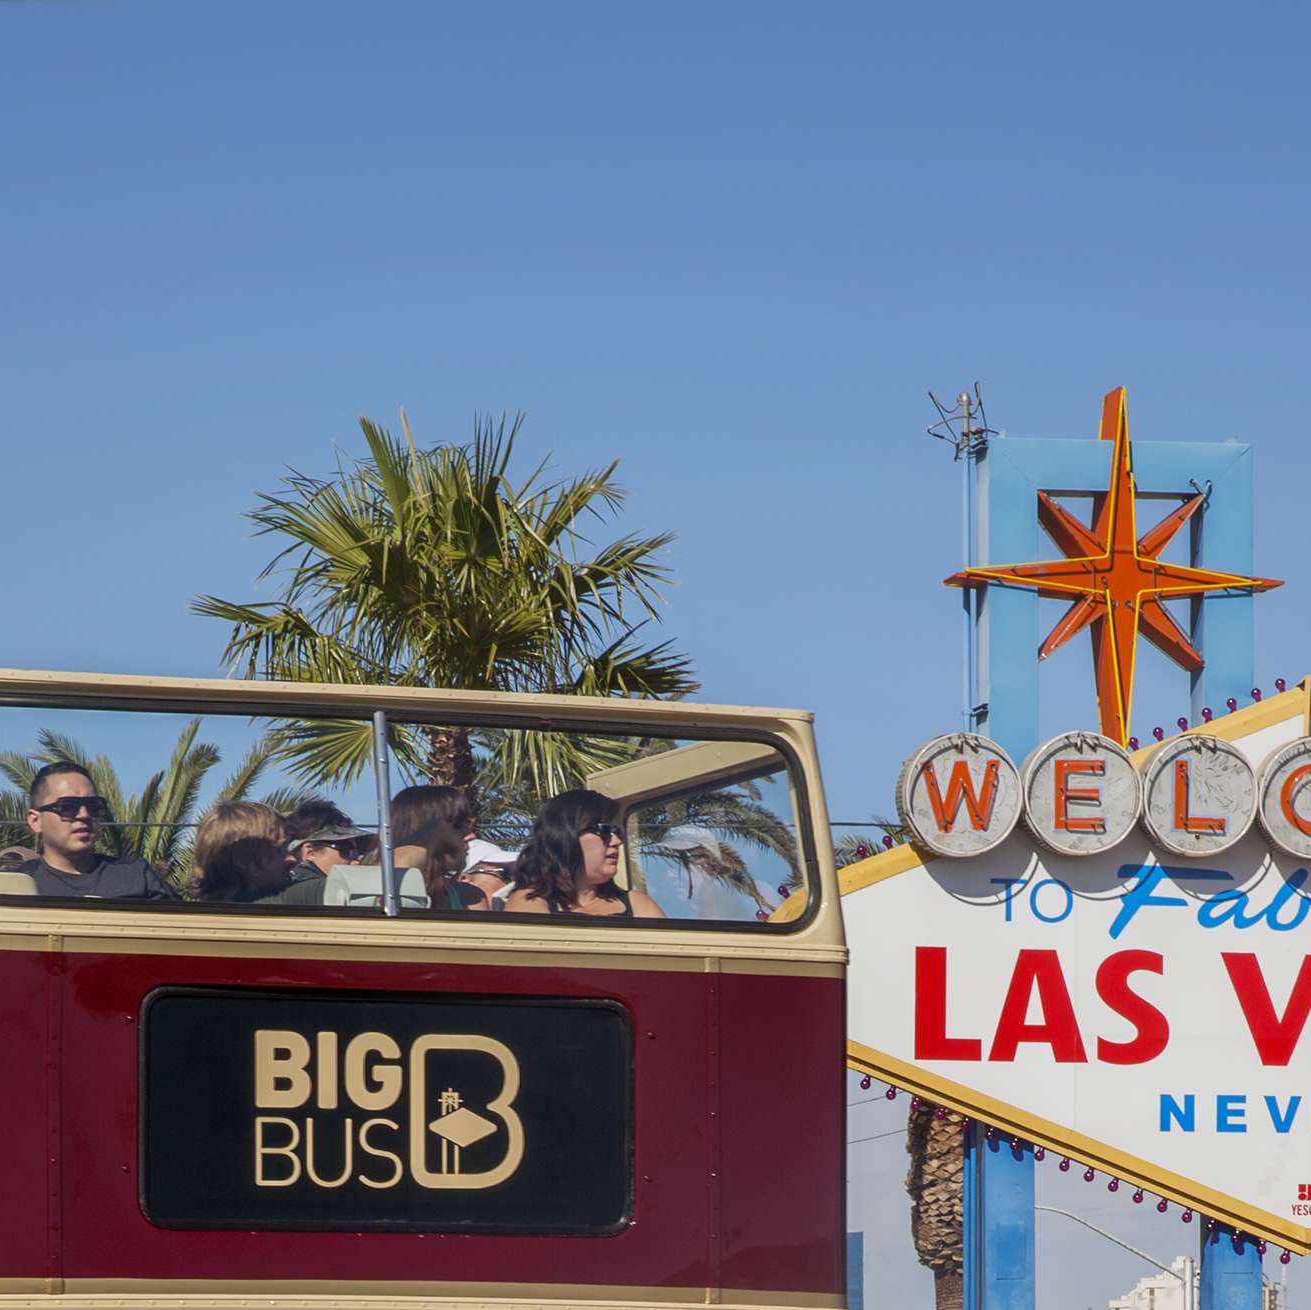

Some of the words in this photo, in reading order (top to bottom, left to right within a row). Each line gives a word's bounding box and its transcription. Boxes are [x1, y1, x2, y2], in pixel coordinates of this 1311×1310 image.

[990, 878, 1074, 924] TO
[913, 945, 1171, 1066] LAS
[254, 1028, 402, 1109] BIG
[254, 1116, 402, 1190] BUS
